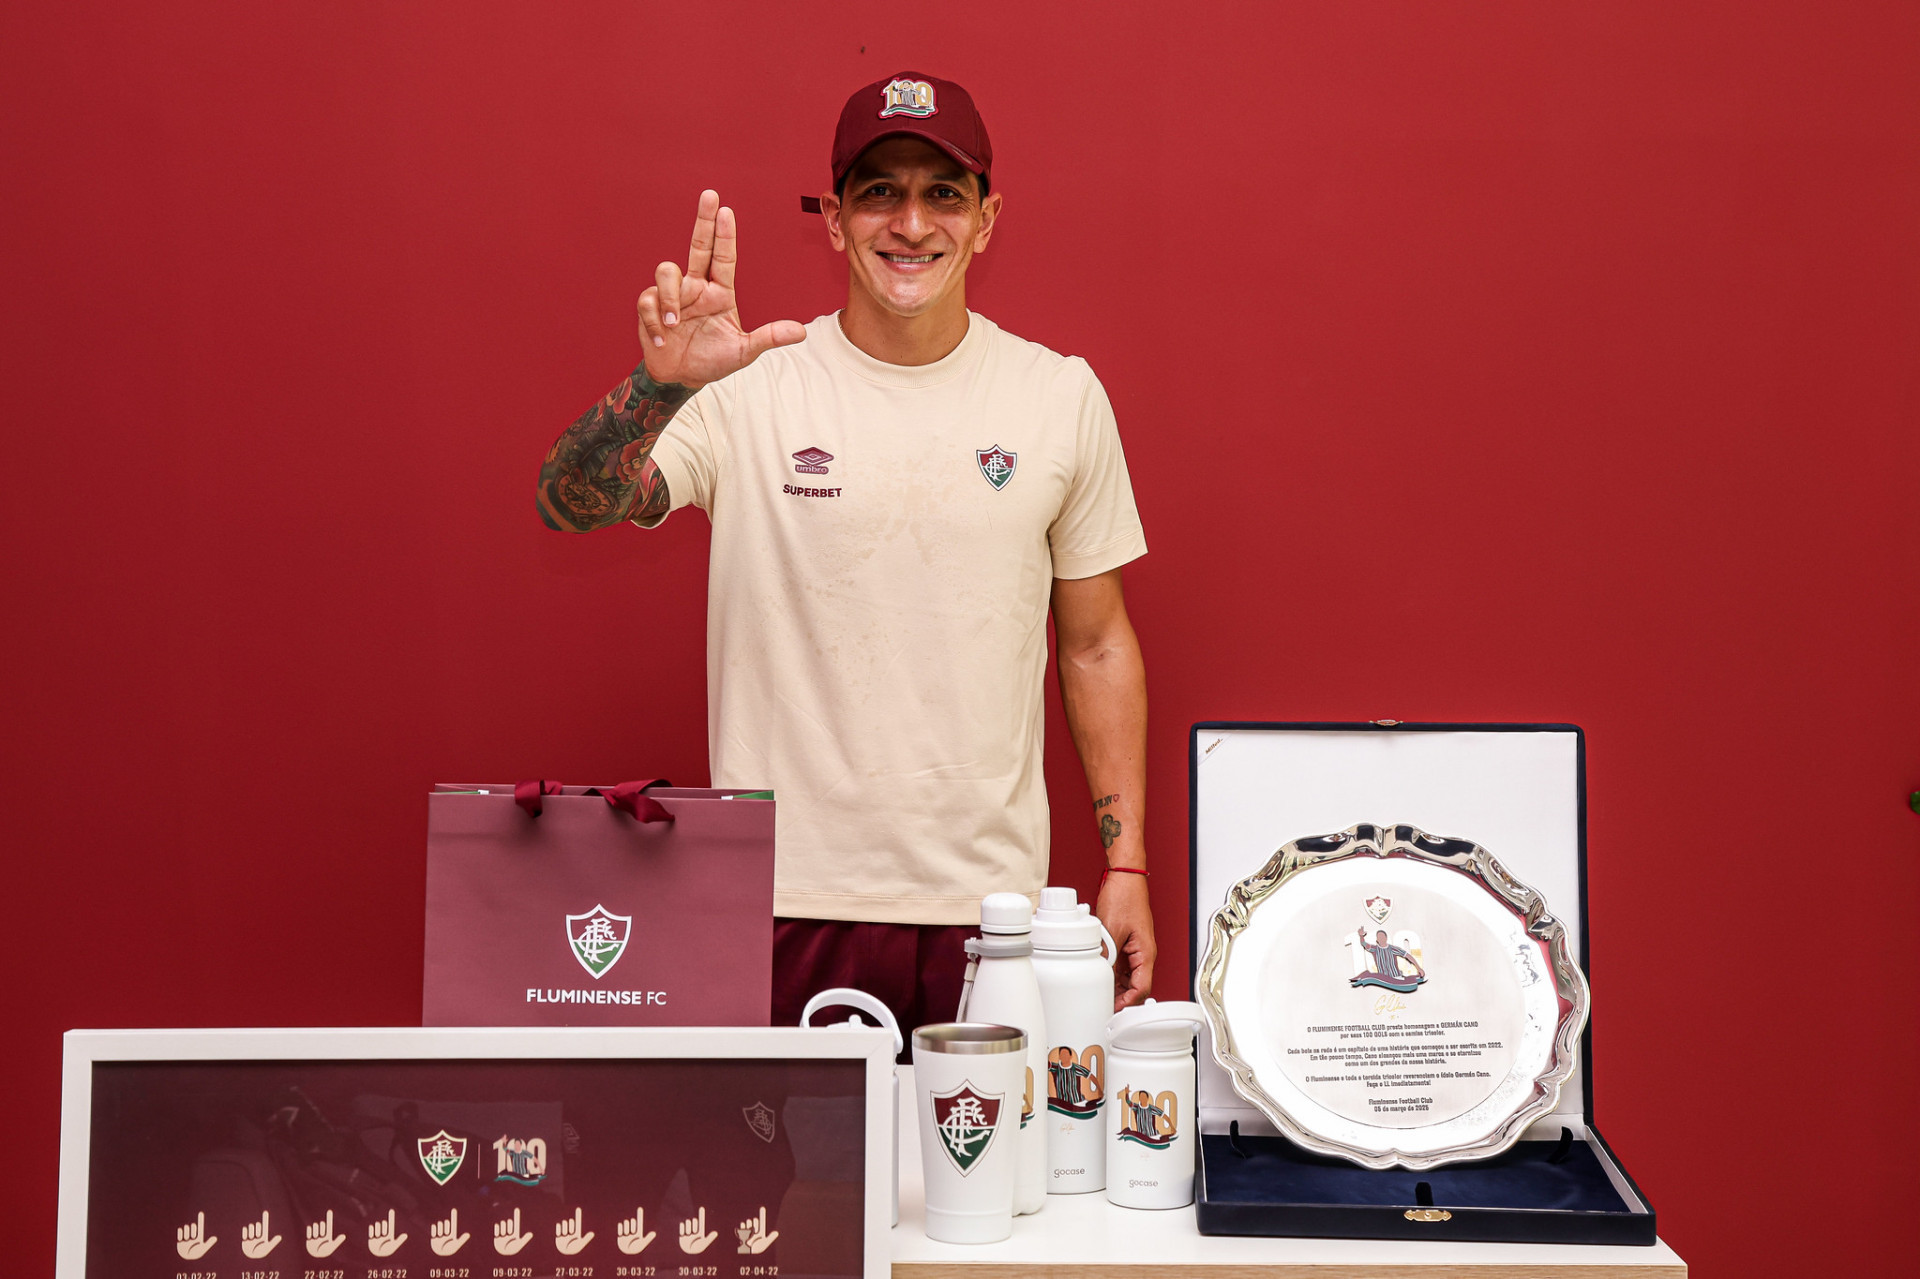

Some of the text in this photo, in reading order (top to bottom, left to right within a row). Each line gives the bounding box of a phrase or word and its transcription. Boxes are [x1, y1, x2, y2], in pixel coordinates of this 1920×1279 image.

[795, 465, 828, 474] umbro
[783, 484, 842, 498] SUPERBET
[526, 988, 667, 1005] FLUMINENSE FC
[1054, 1168, 1085, 1178] gocase
[1129, 1179, 1158, 1188] gocase
